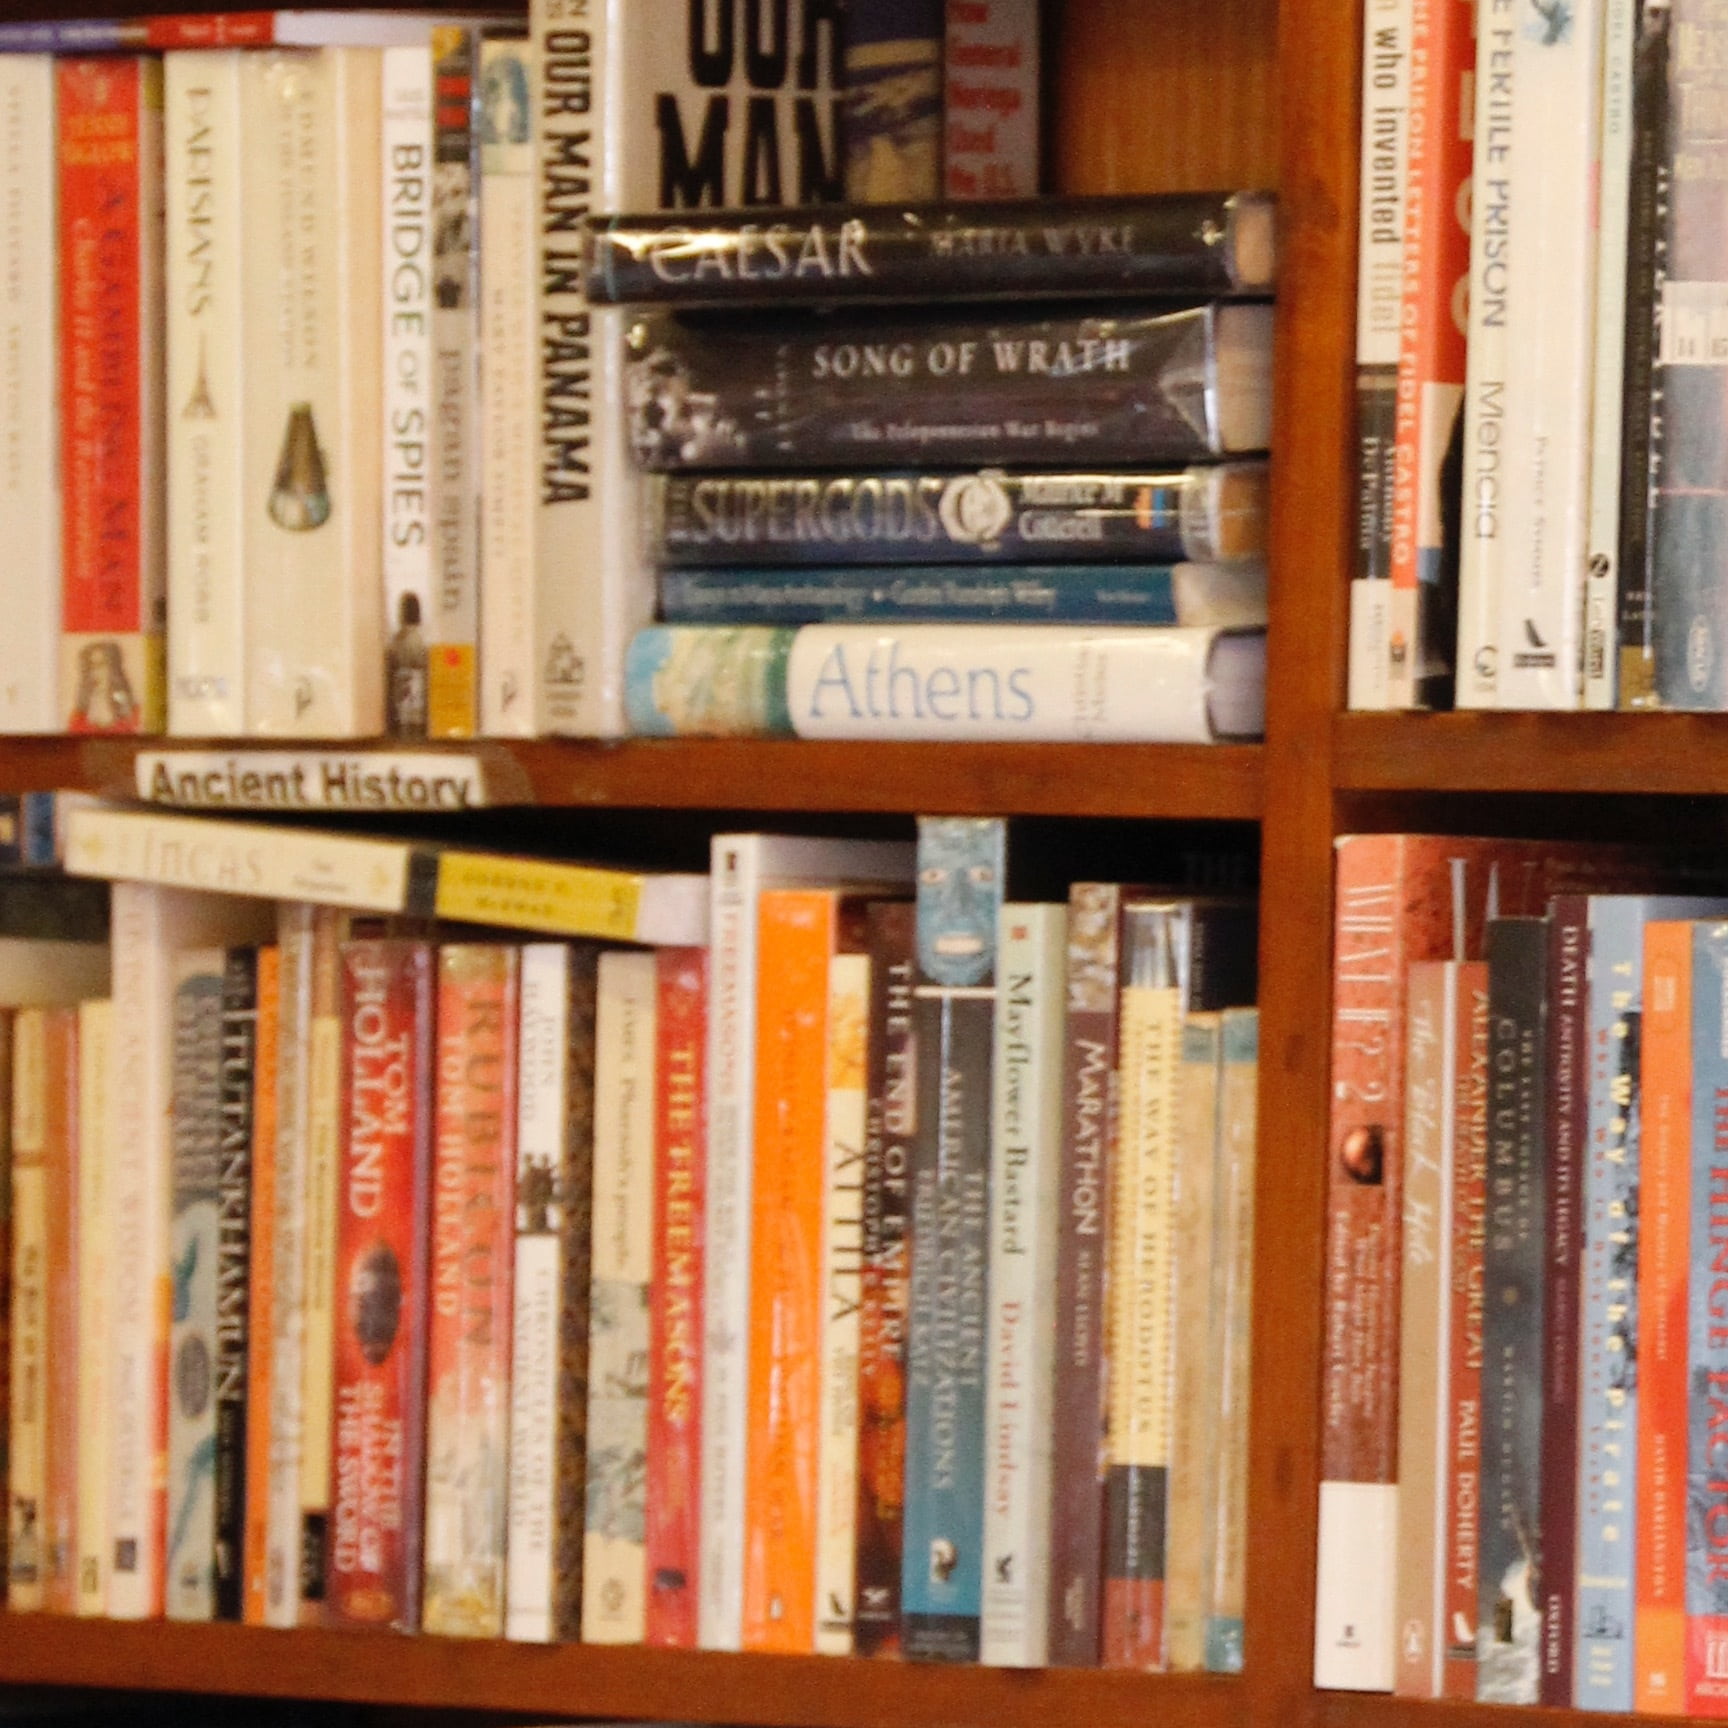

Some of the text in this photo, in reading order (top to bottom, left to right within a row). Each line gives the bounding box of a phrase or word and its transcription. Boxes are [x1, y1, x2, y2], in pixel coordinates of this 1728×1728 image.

[654, 93, 843, 208] MAN
[542, 29, 593, 506] OUR MAN IN PANAMA
[652, 221, 873, 283] CAESAR
[391, 142, 426, 548] BRIDGE OF SPIES
[811, 337, 1132, 378] SONG OF WRATH
[809, 642, 1035, 720] Athens
[150, 758, 472, 809] Ancient History
[348, 970, 390, 1219] HOLLAND
[384, 1033, 409, 1135] TOM
[1000, 973, 1034, 1255] Mayflower Bastard
[1072, 1038, 1107, 1236] MARATHON
[661, 1043, 699, 1422] THE FREEMASONS
[828, 1141, 864, 1324] ATTILA
